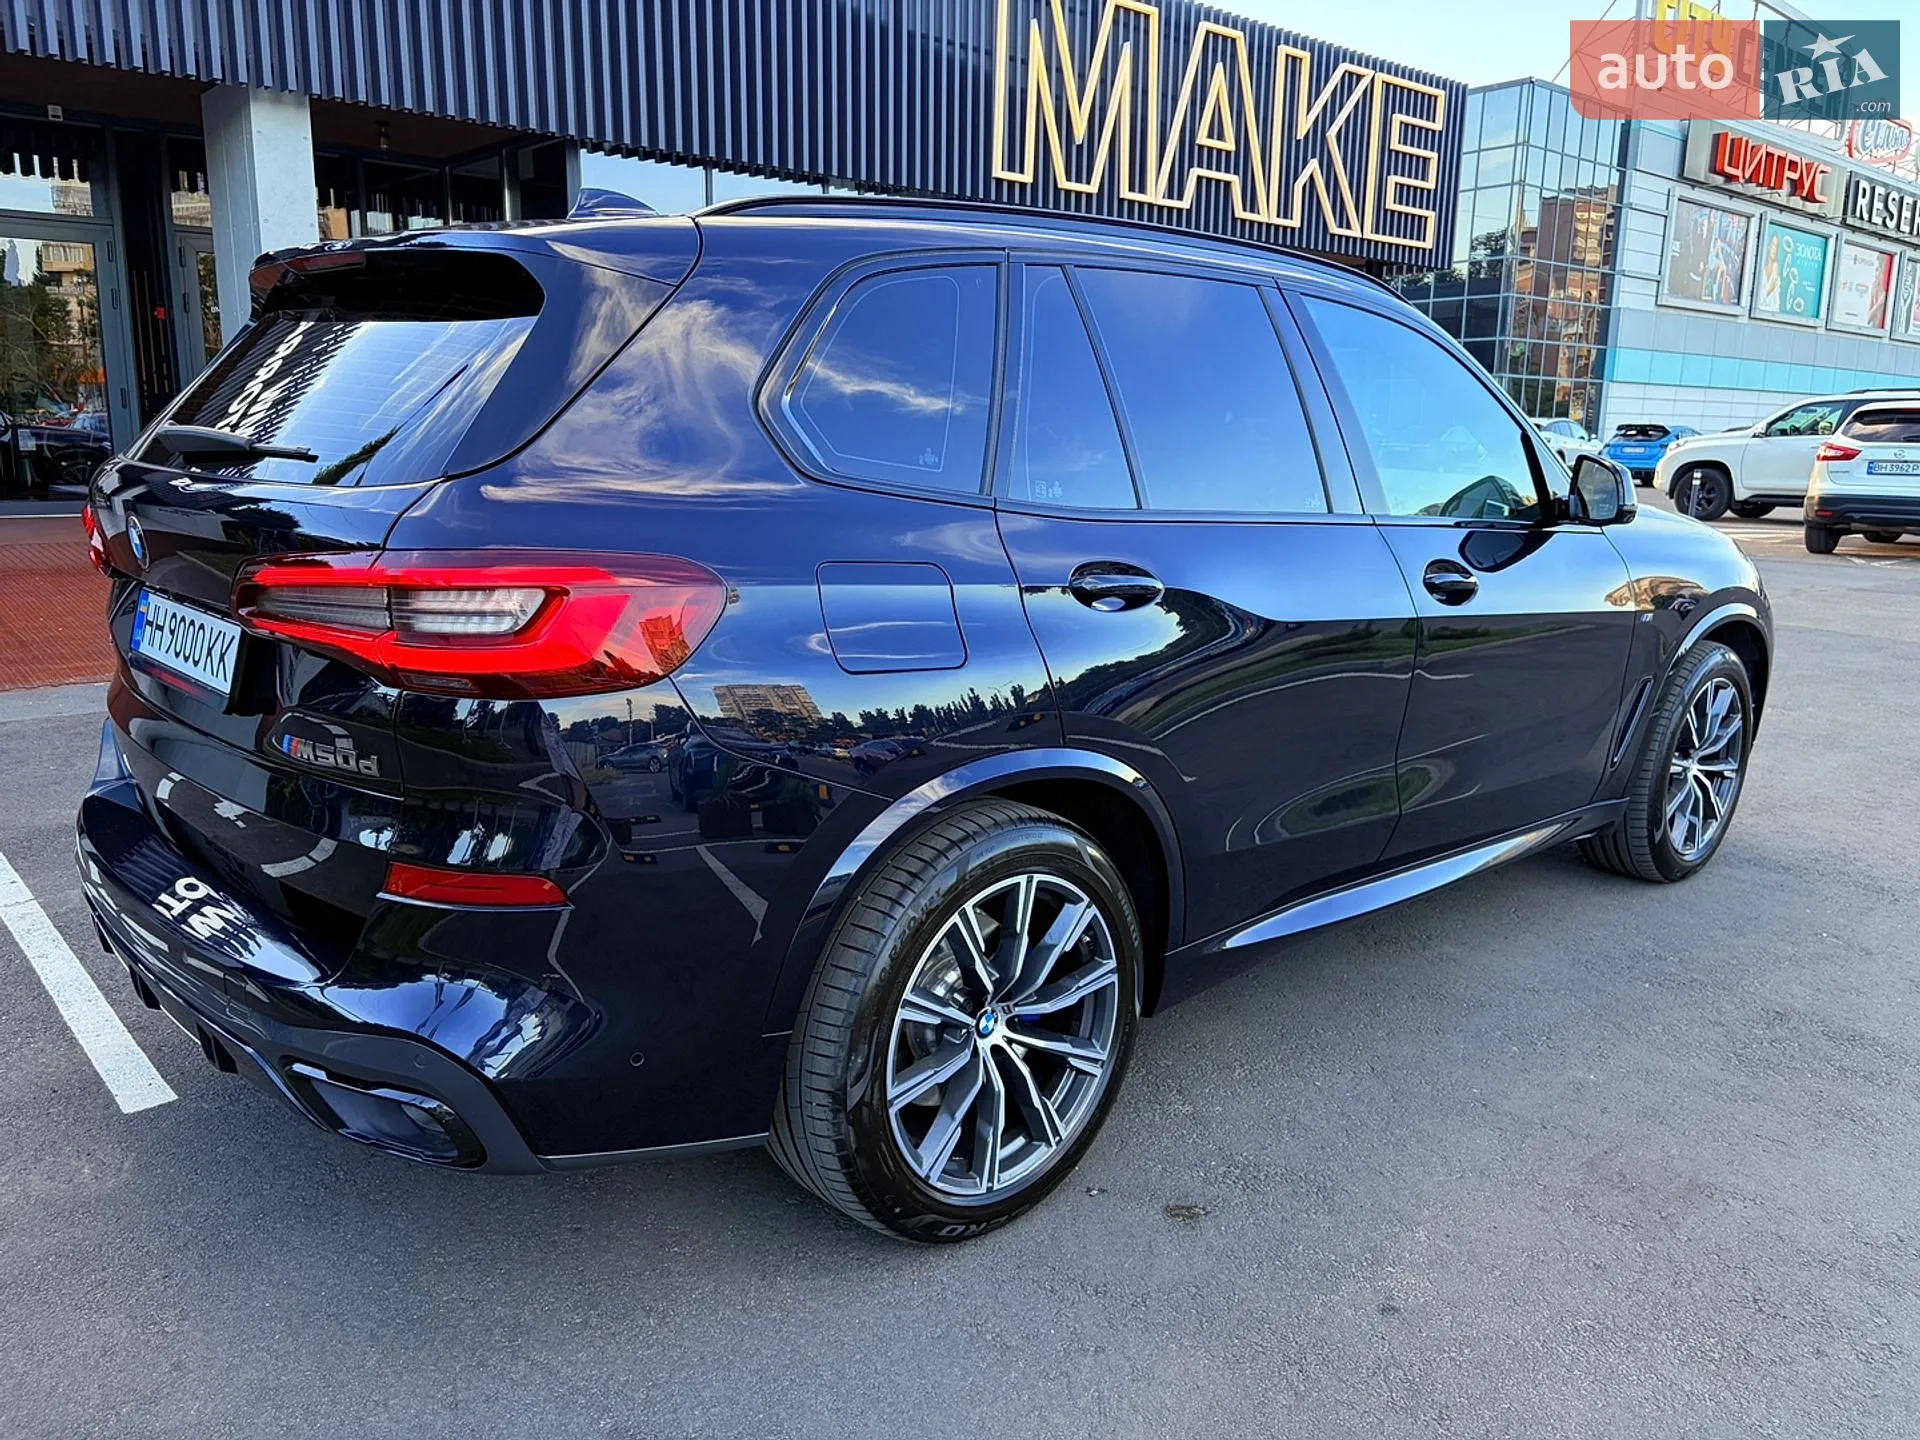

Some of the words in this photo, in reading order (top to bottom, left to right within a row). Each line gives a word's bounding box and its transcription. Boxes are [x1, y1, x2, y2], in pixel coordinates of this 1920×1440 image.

[992, 0, 1446, 249] MAKE
[1715, 132, 1833, 205] ЦИТРУС
[297, 738, 380, 777] M50d
